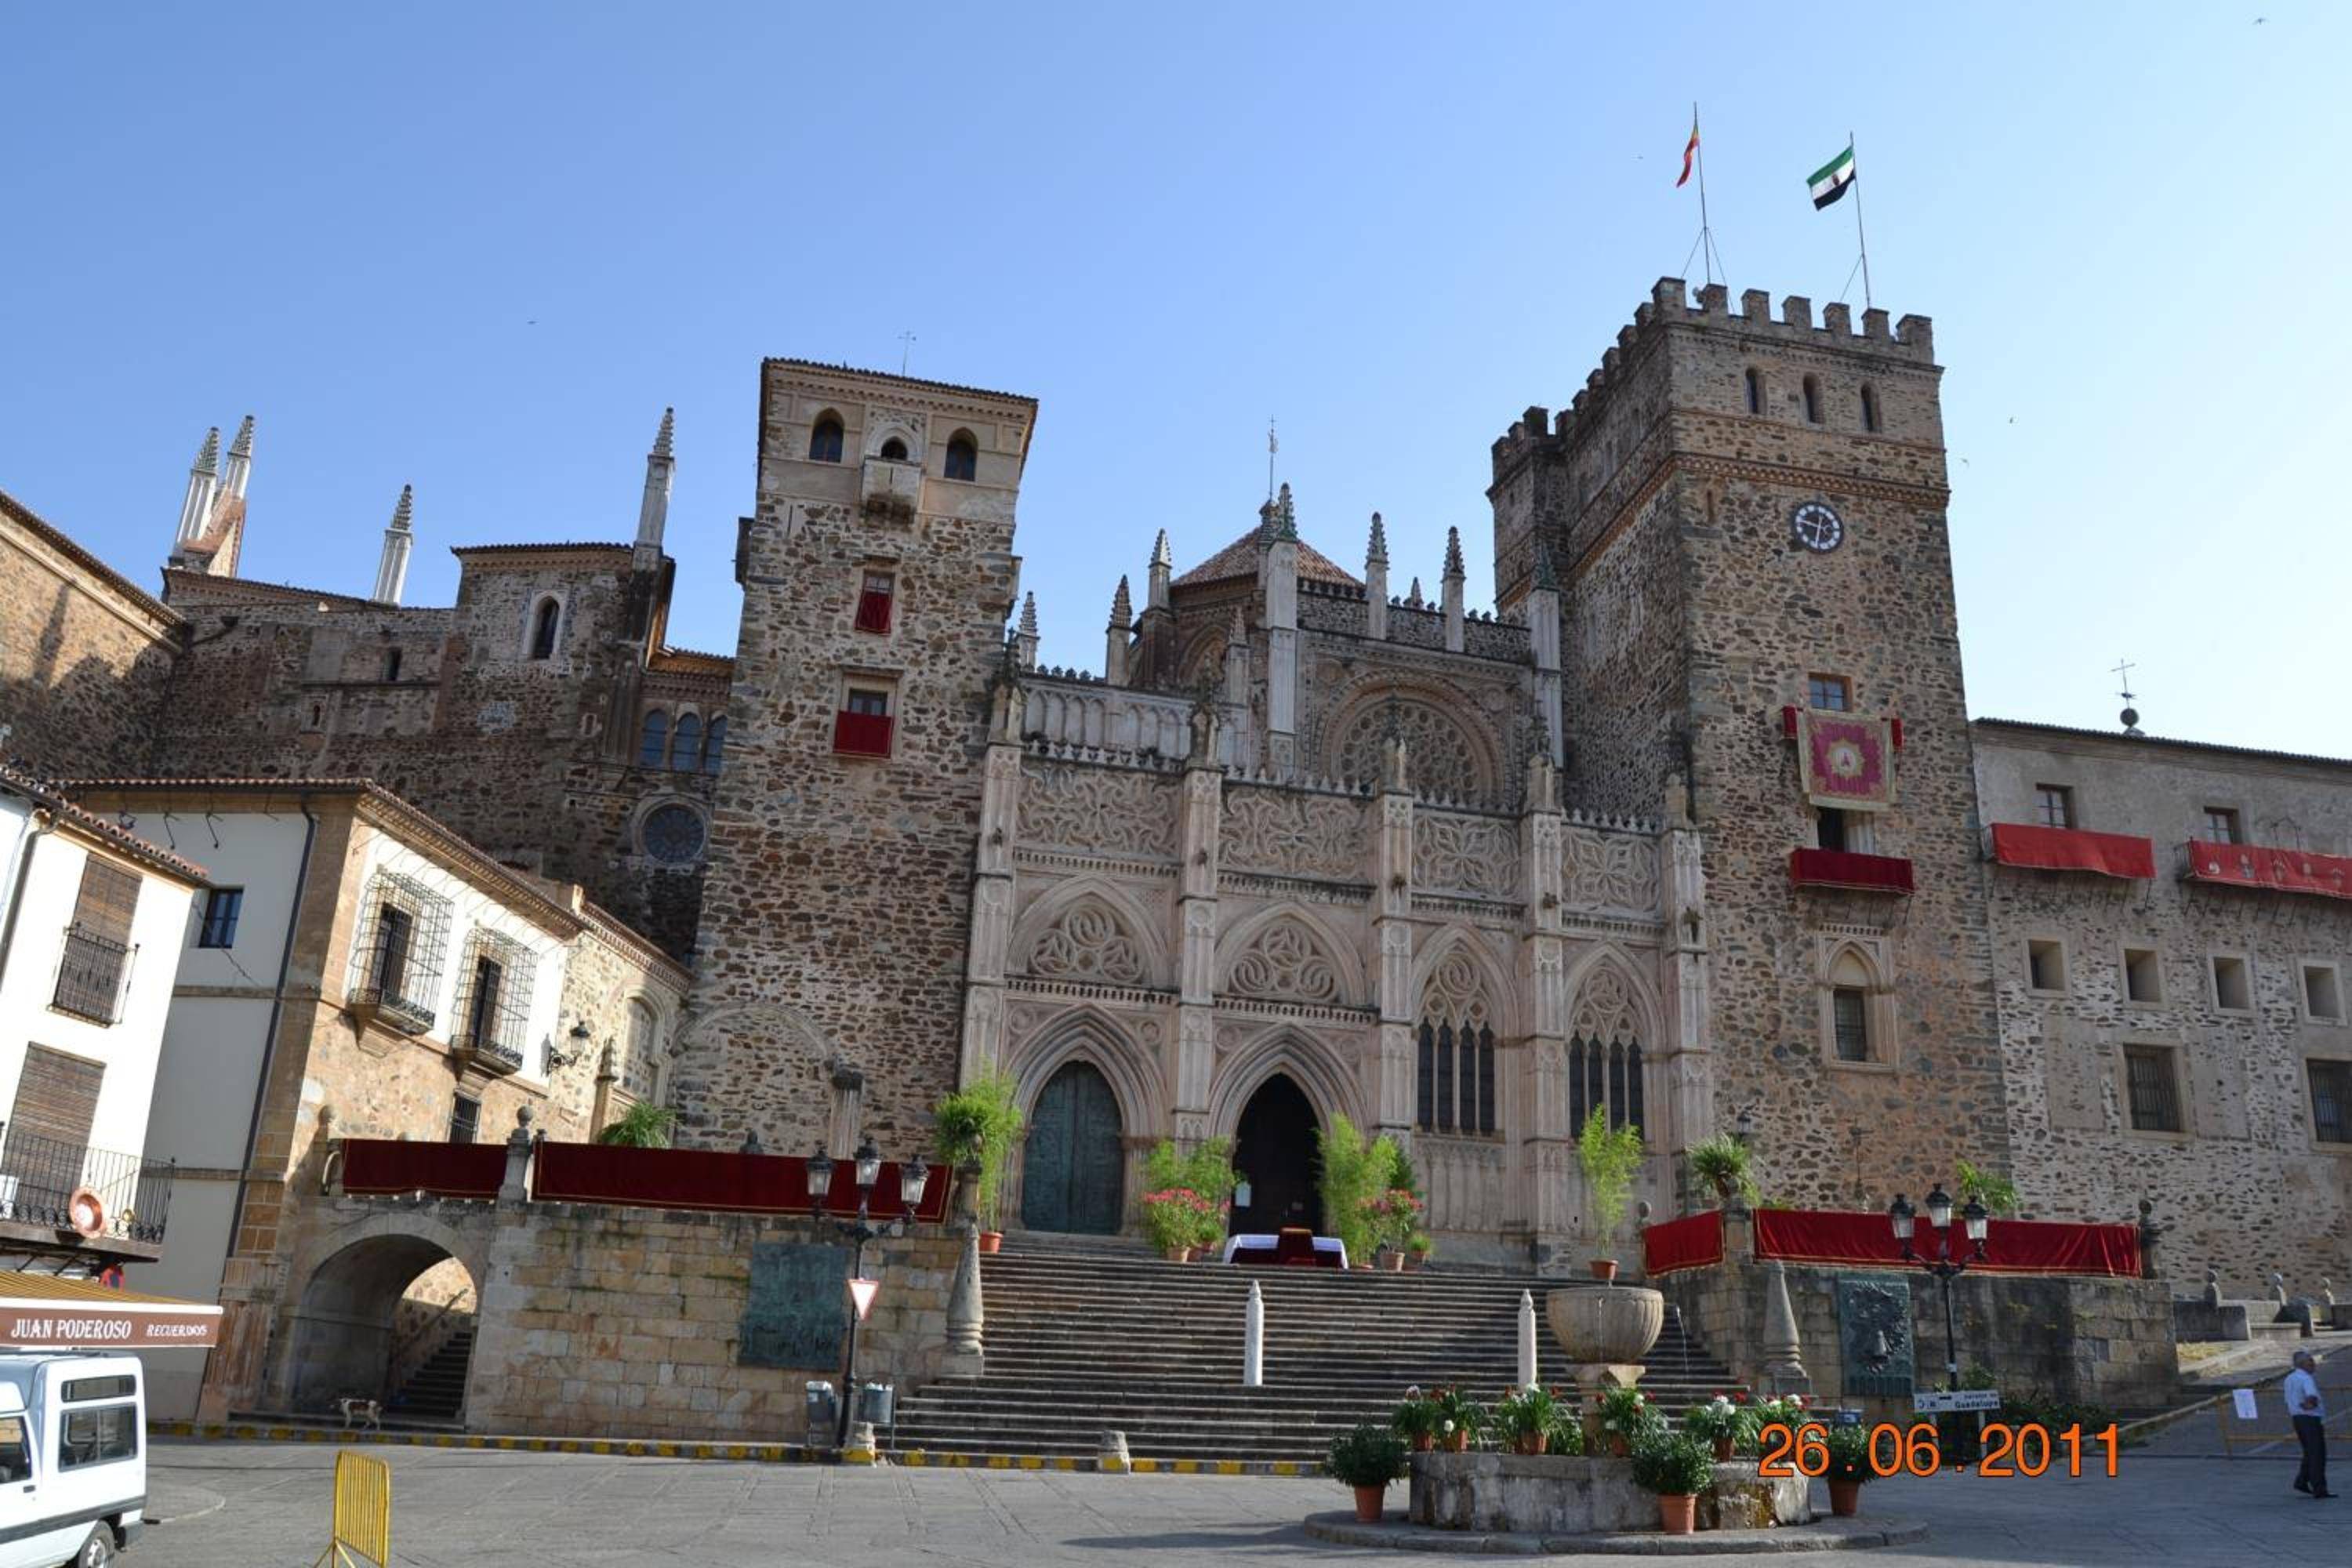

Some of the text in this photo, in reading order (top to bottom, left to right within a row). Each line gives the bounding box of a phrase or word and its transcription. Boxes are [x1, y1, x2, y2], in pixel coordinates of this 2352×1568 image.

[11, 1319, 209, 1340] JUAN PODEROSO RECUERDOS
